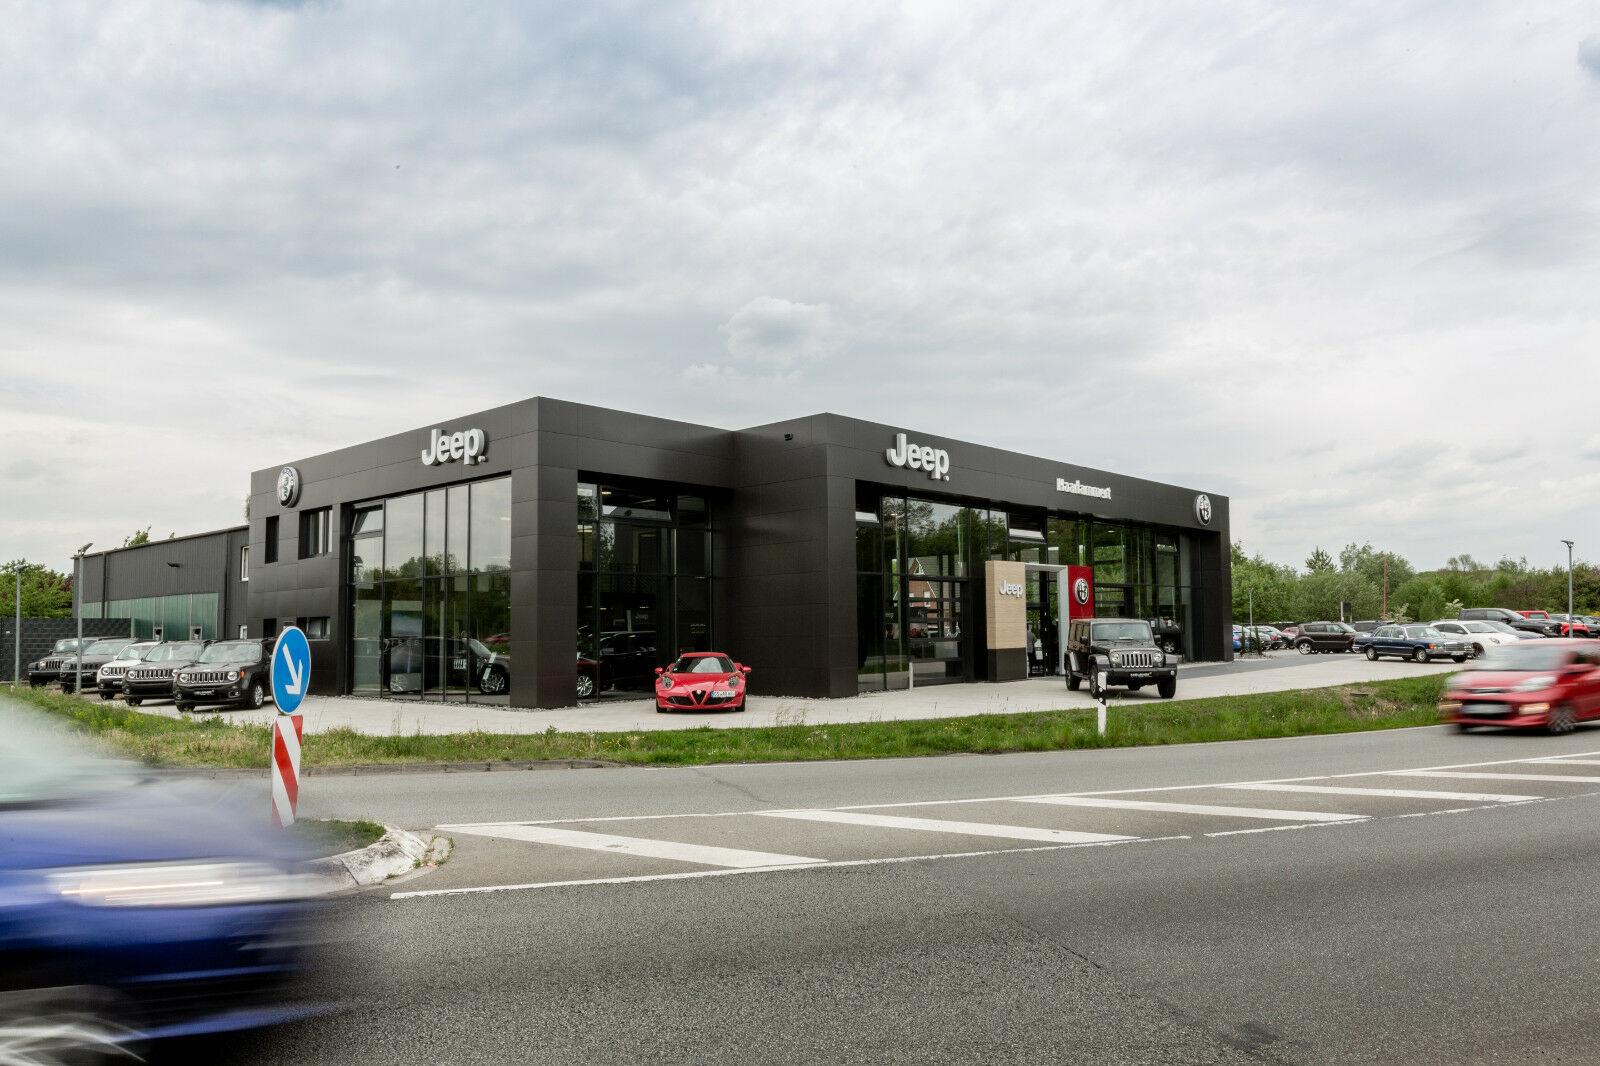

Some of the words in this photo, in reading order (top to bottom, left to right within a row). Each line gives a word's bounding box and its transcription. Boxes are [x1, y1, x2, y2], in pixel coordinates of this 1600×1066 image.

[421, 428, 485, 466] Jeep
[886, 432, 950, 480] Jeep
[1000, 579, 1023, 598] Jeep
